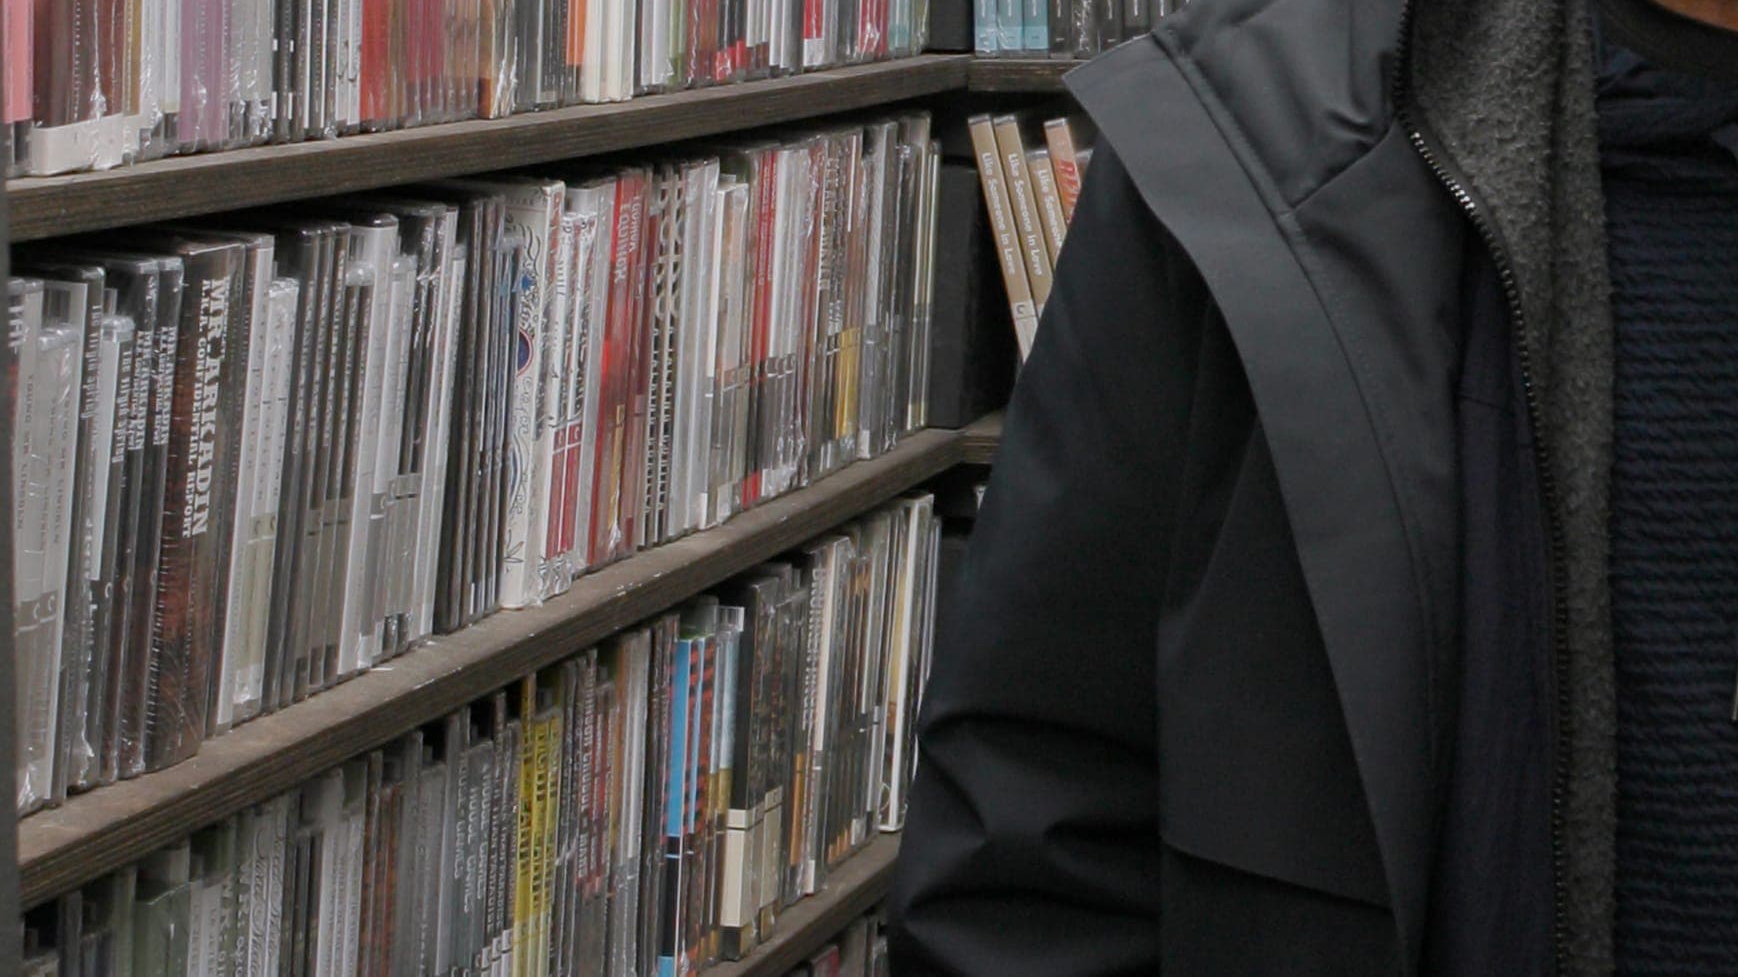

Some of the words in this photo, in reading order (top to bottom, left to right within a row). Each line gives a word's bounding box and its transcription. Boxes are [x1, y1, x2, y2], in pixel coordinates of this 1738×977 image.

[1007, 153, 1019, 177] Like
[1014, 181, 1033, 232] Someone
[1030, 249, 1043, 276] Love
[188, 338, 207, 465] CONFIDENTIAL
[191, 357, 221, 536] ARKADIN
[182, 471, 196, 538] REPORT
